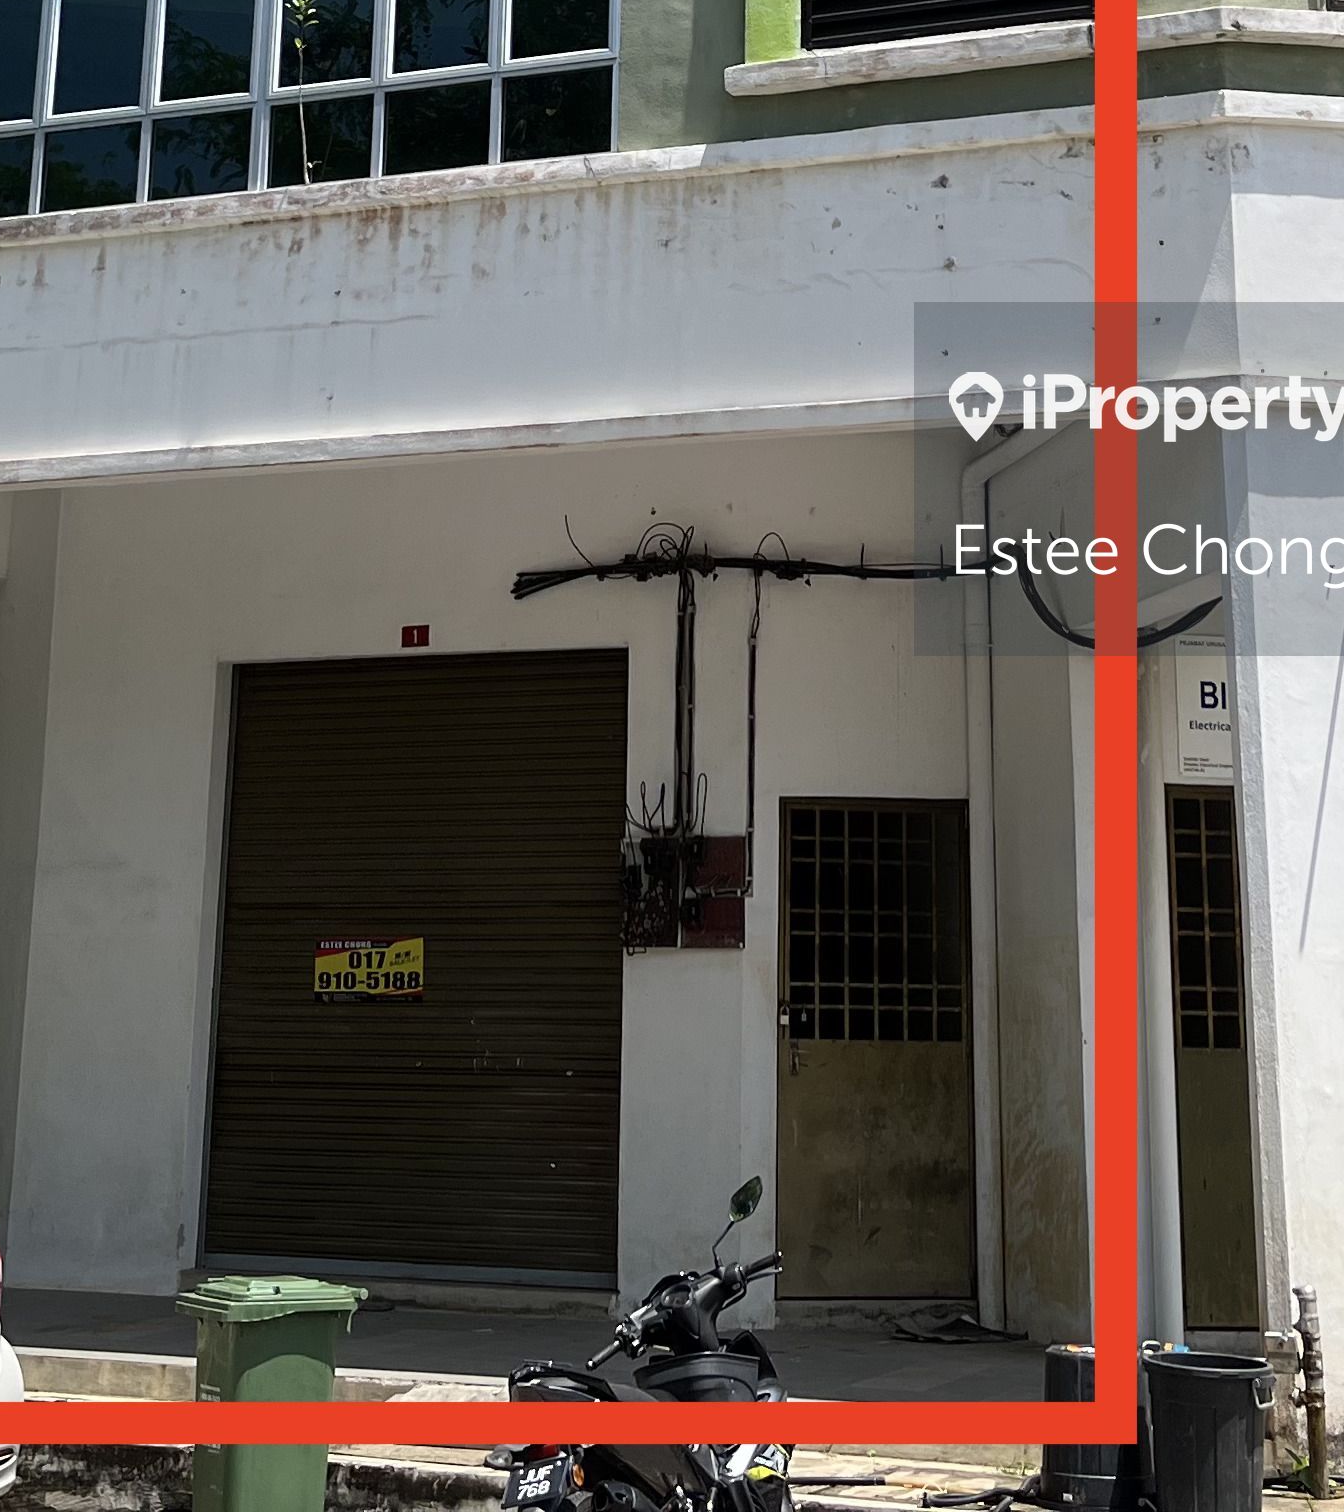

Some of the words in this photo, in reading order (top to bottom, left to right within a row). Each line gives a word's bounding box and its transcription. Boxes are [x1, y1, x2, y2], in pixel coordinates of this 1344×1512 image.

[348, 951, 387, 969] 017
[317, 971, 421, 990] 910-5188
[517, 1480, 551, 1500] 768
